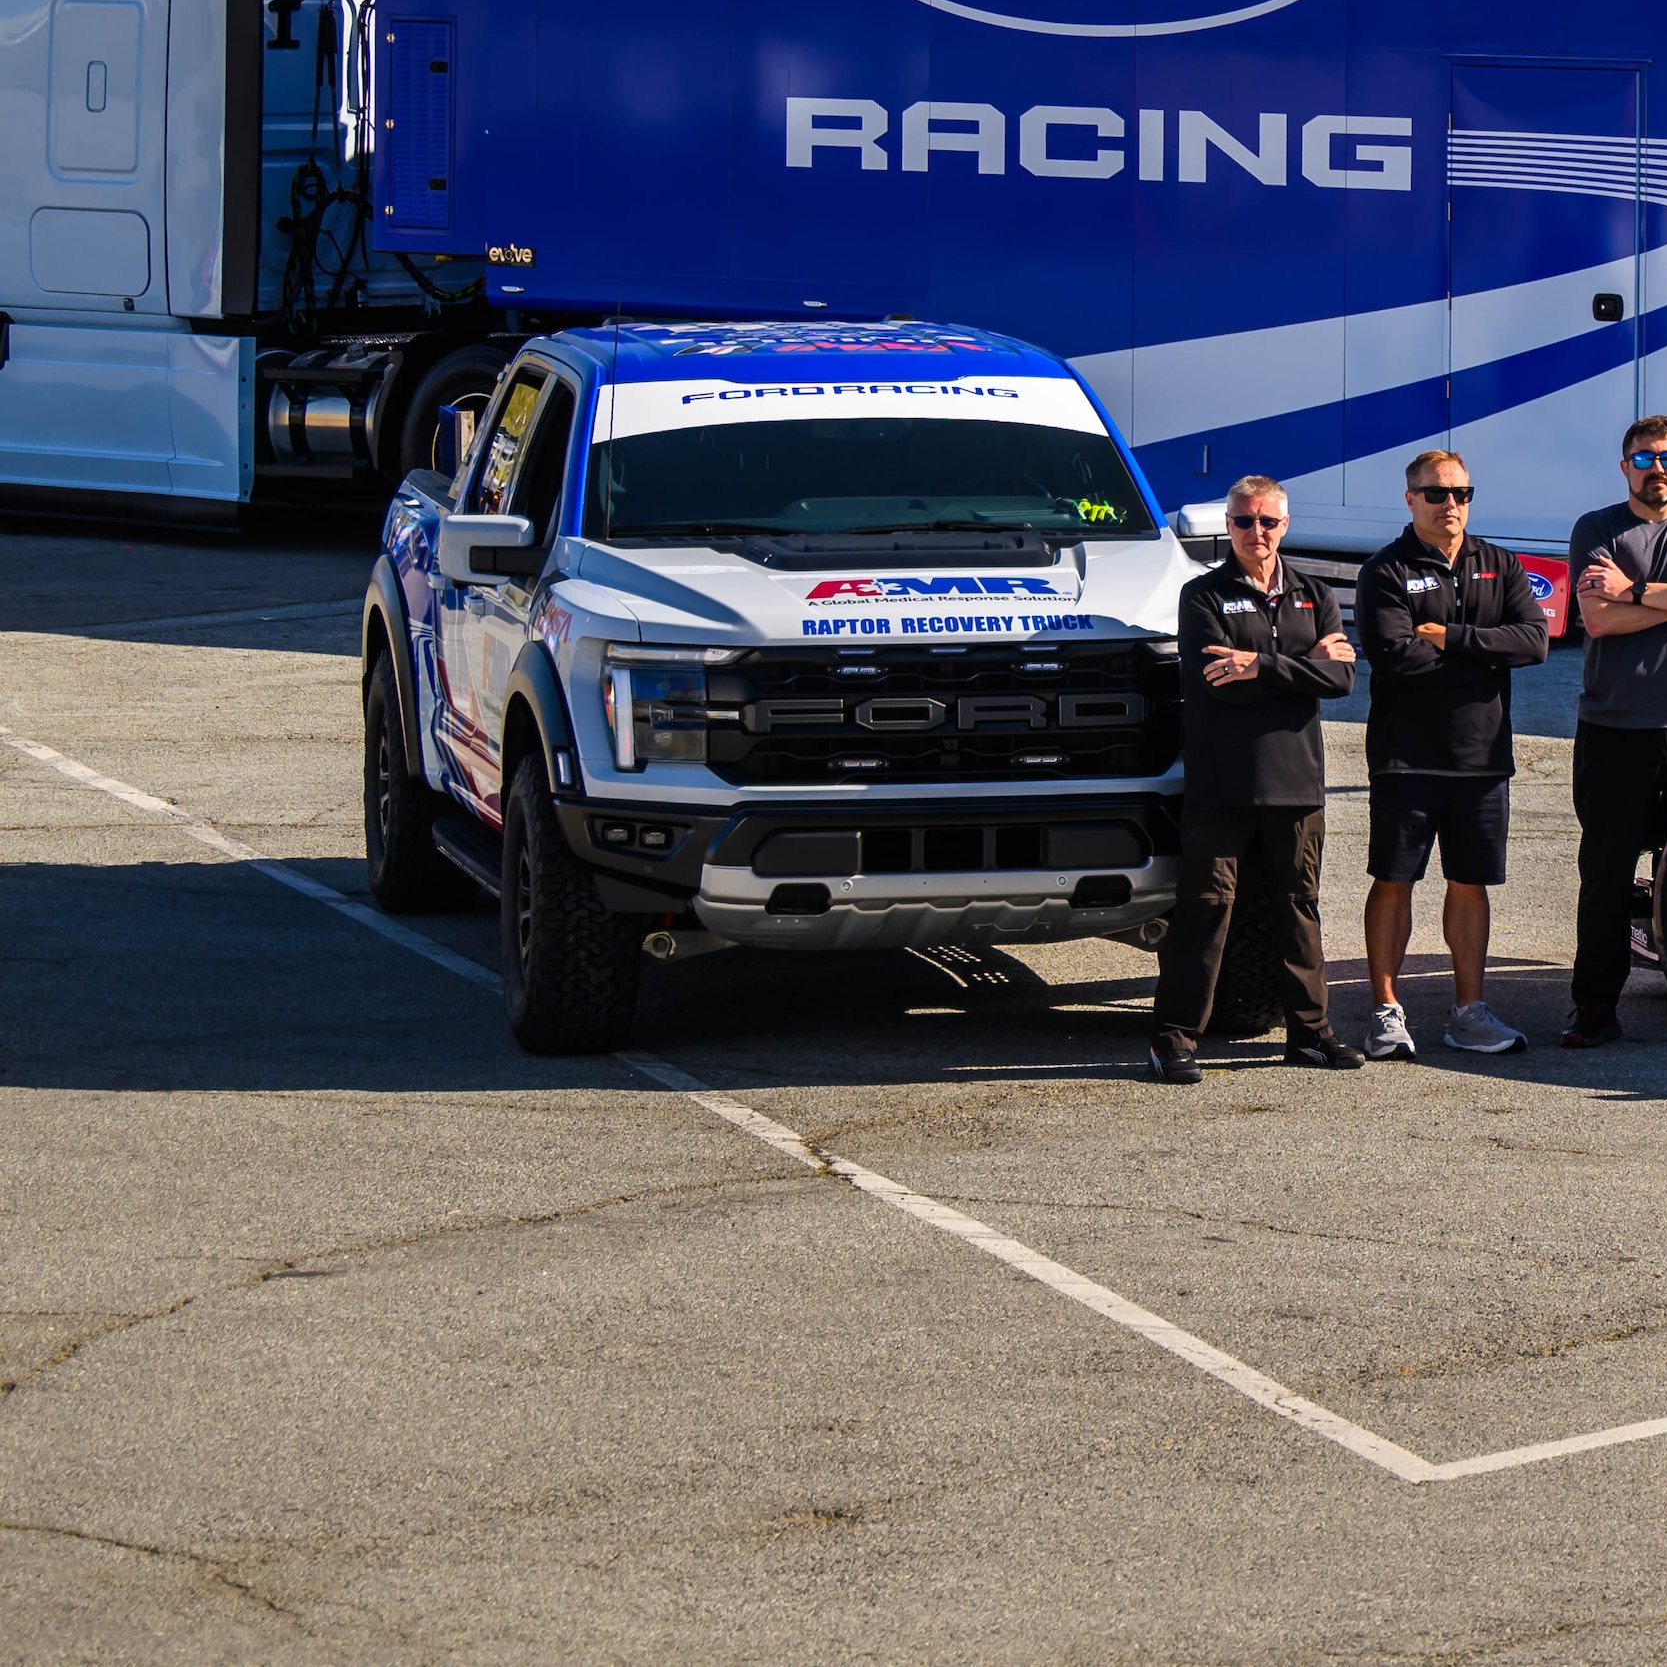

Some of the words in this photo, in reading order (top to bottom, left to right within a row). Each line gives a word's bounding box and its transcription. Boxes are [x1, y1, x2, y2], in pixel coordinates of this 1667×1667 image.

[786, 96, 1412, 191] RACING
[682, 385, 824, 405] FORD
[833, 384, 1019, 399] RACING
[805, 577, 1062, 600] AMR
[820, 598, 872, 607] Global
[874, 595, 935, 604] Medical
[938, 595, 1010, 604] Response
[1013, 594, 1078, 603] Solution
[802, 618, 891, 636] RAPTOR
[901, 615, 1013, 634] RECOVERY
[1018, 613, 1096, 632] TRUCK
[743, 692, 1146, 733] FORD
